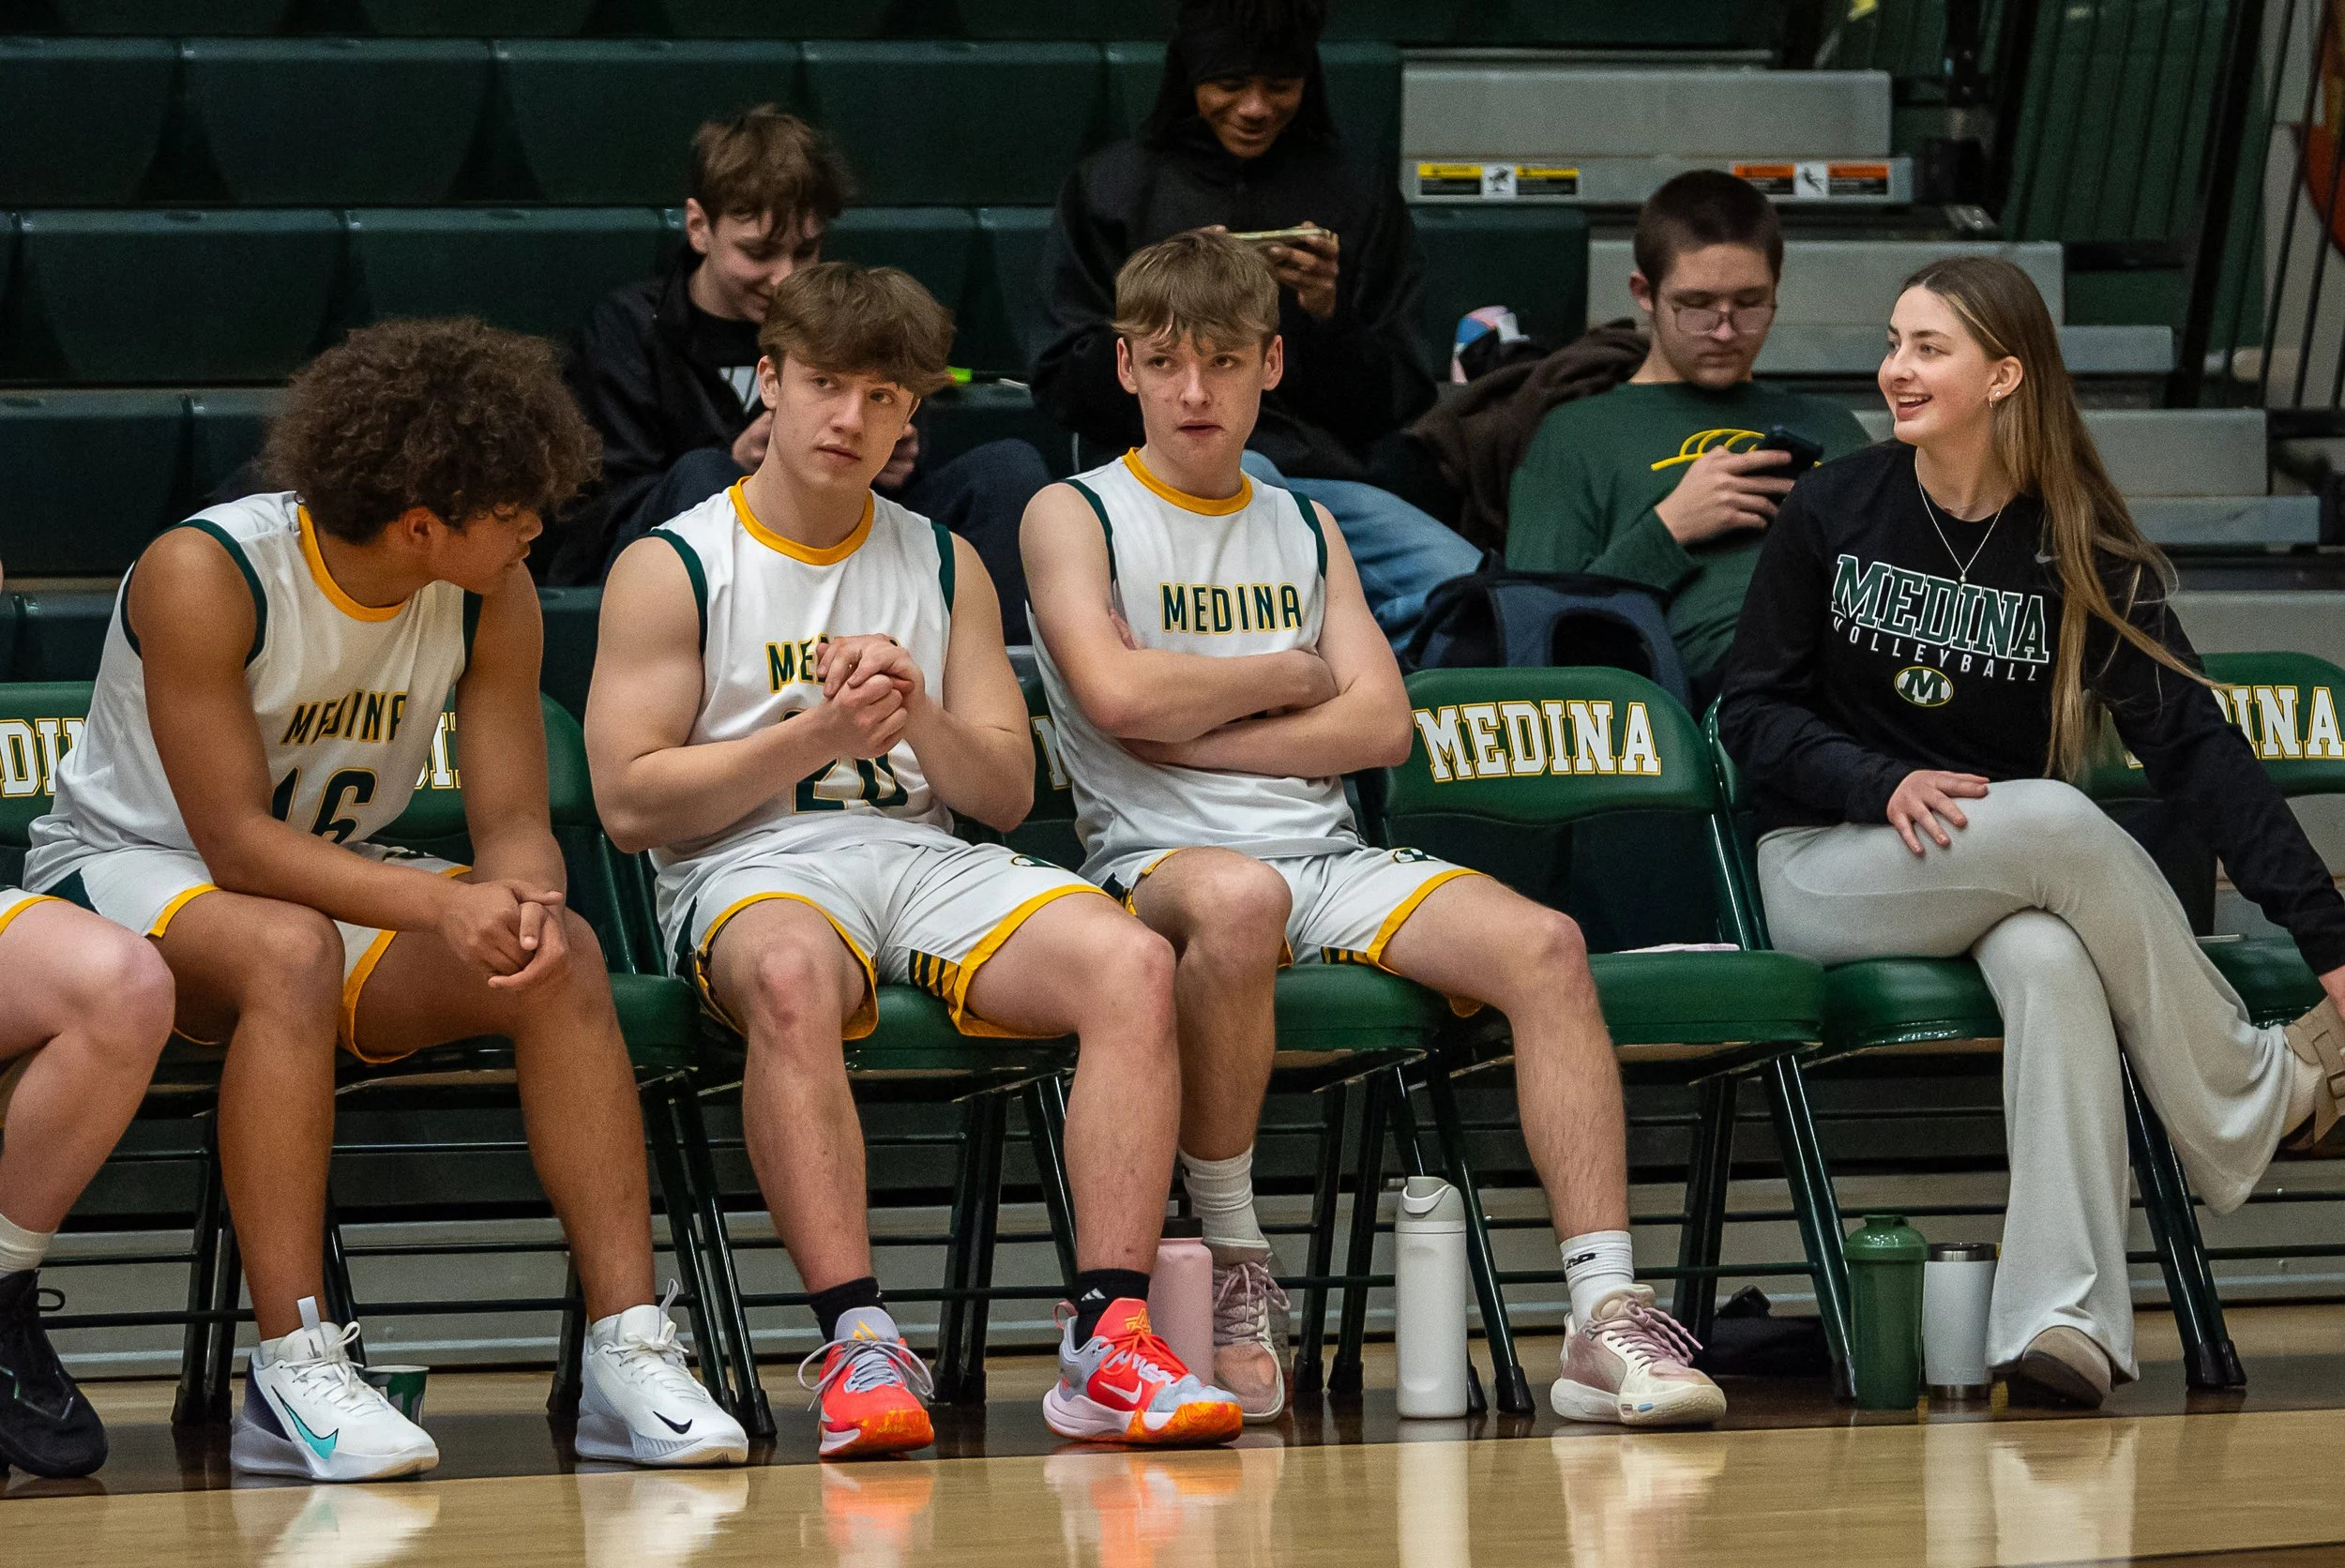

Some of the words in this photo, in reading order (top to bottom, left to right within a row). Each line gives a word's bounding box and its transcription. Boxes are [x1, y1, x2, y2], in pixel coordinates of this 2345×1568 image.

[1159, 581, 1305, 636] MEDINA
[1832, 553, 2050, 664] MEDINA
[1833, 615, 2036, 682] VOLLEYBALL
[1413, 700, 1662, 783] MEDINA
